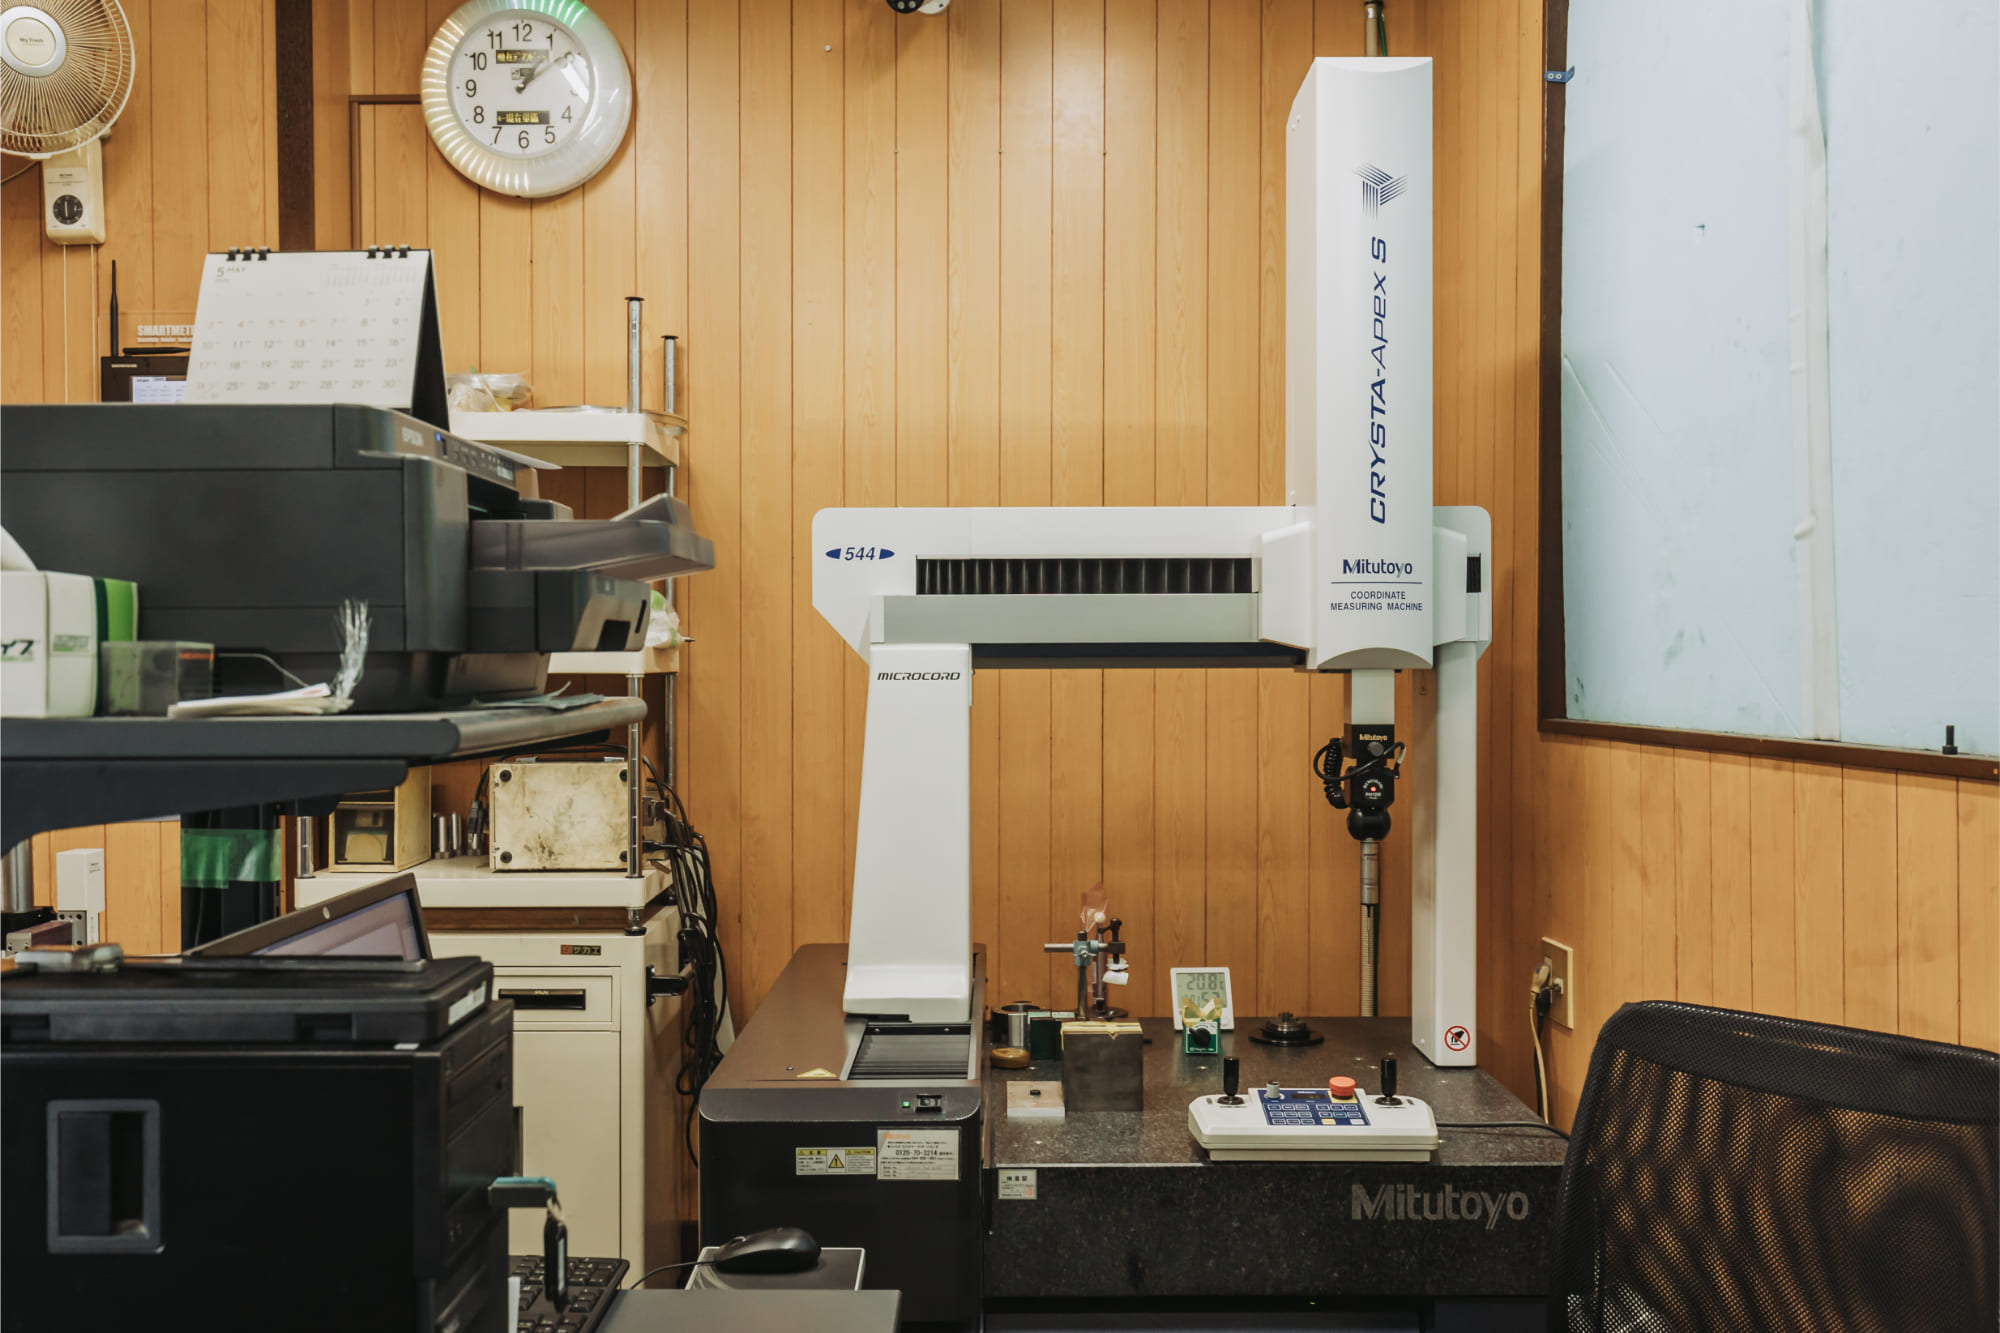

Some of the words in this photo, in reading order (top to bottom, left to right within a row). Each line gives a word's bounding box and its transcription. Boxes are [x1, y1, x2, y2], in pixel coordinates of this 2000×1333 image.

[486, 31, 503, 49] 11
[511, 23, 532, 42] 12
[546, 33, 553, 49] 1
[469, 52, 487, 71] 10
[465, 79, 477, 98] 9
[473, 105, 485, 124] 8
[561, 104, 573, 123] 4
[491, 126, 502, 144] 7
[518, 130, 529, 149] 6
[544, 125, 556, 144] 5
[1370, 236, 1387, 264] S
[216, 267, 225, 277] 5
[844, 547, 876, 561] 544
[1342, 558, 1413, 578] Mitutoyo
[1350, 591, 1406, 600] COORDINATE
[1330, 602, 1383, 611] MEASURING
[1387, 602, 1423, 611] MACHINE
[877, 672, 961, 681] MICROCORD
[1359, 733, 1388, 742] Mitutoyo
[1351, 1183, 1529, 1230] Mitutoyo
